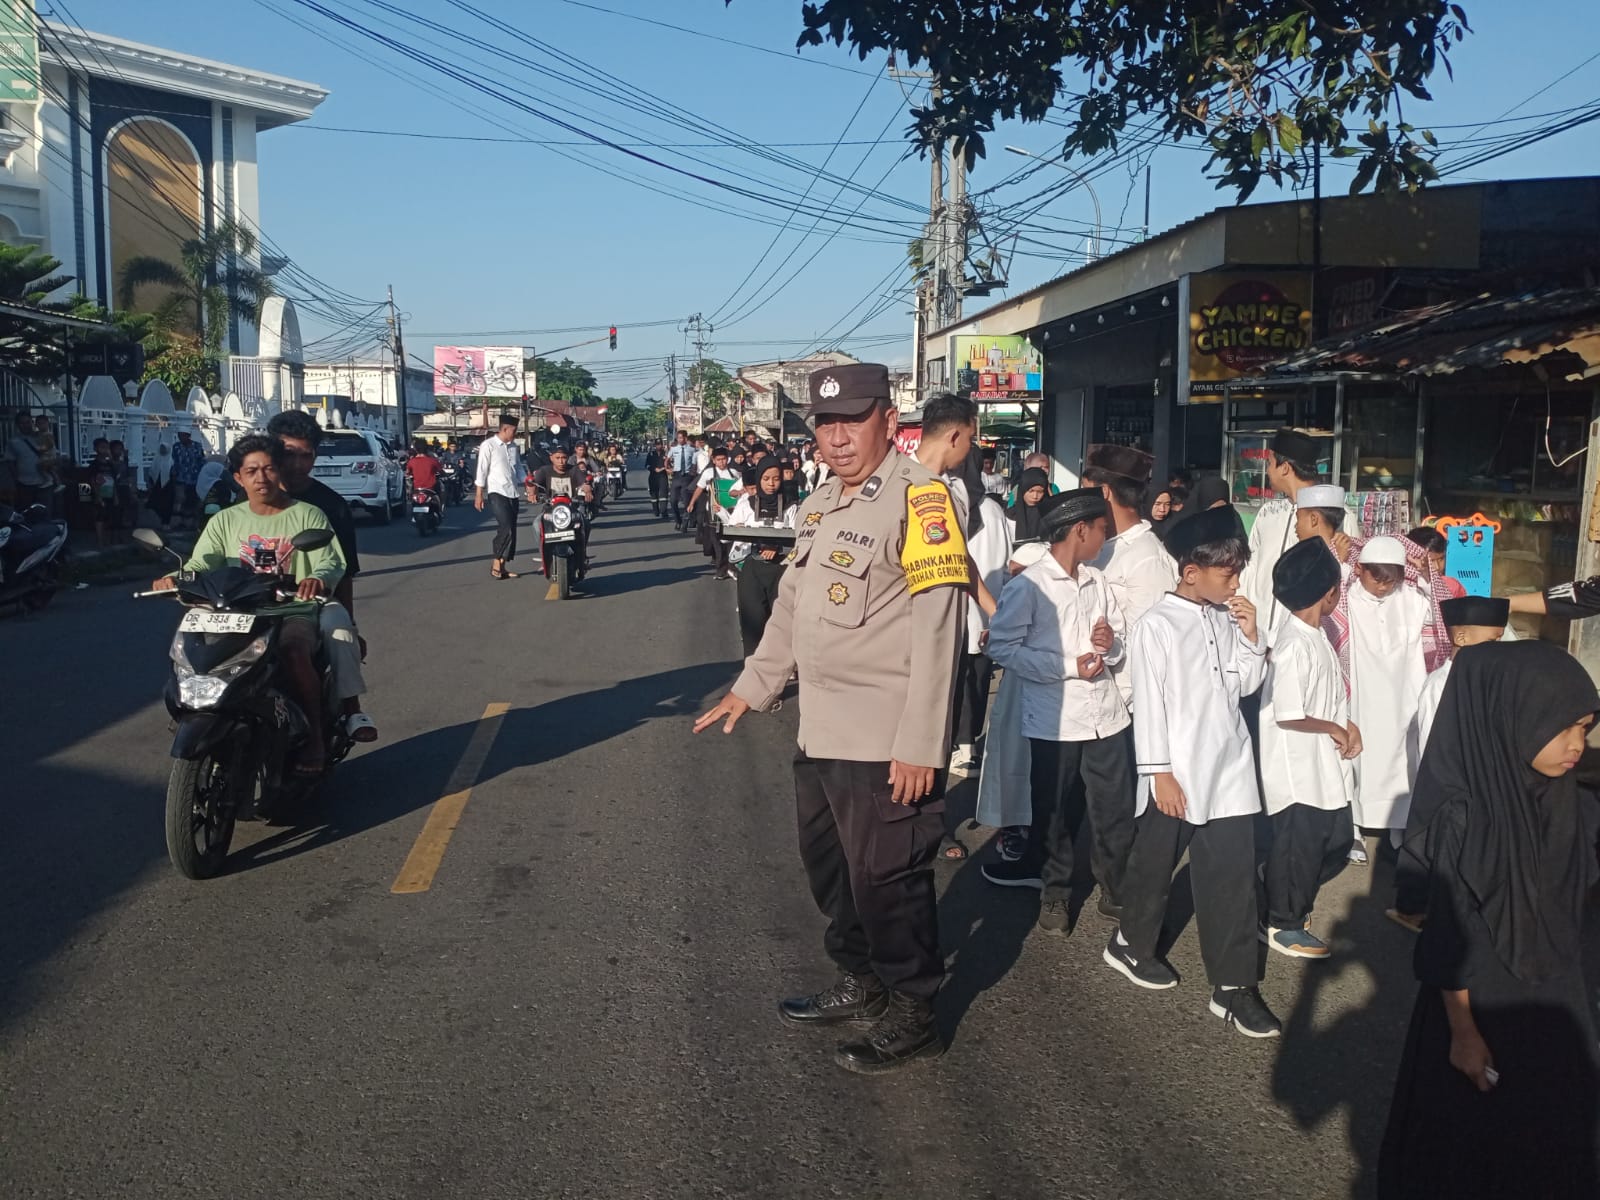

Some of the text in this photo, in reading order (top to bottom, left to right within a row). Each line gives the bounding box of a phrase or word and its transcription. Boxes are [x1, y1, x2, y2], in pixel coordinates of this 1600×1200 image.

[1201, 303, 1298, 326] YAMME
[1197, 326, 1304, 351] CHICKEN
[1192, 383, 1213, 392] AYAM
[836, 530, 875, 549] POLRI
[185, 613, 201, 622] DR
[237, 614, 253, 624] CV
